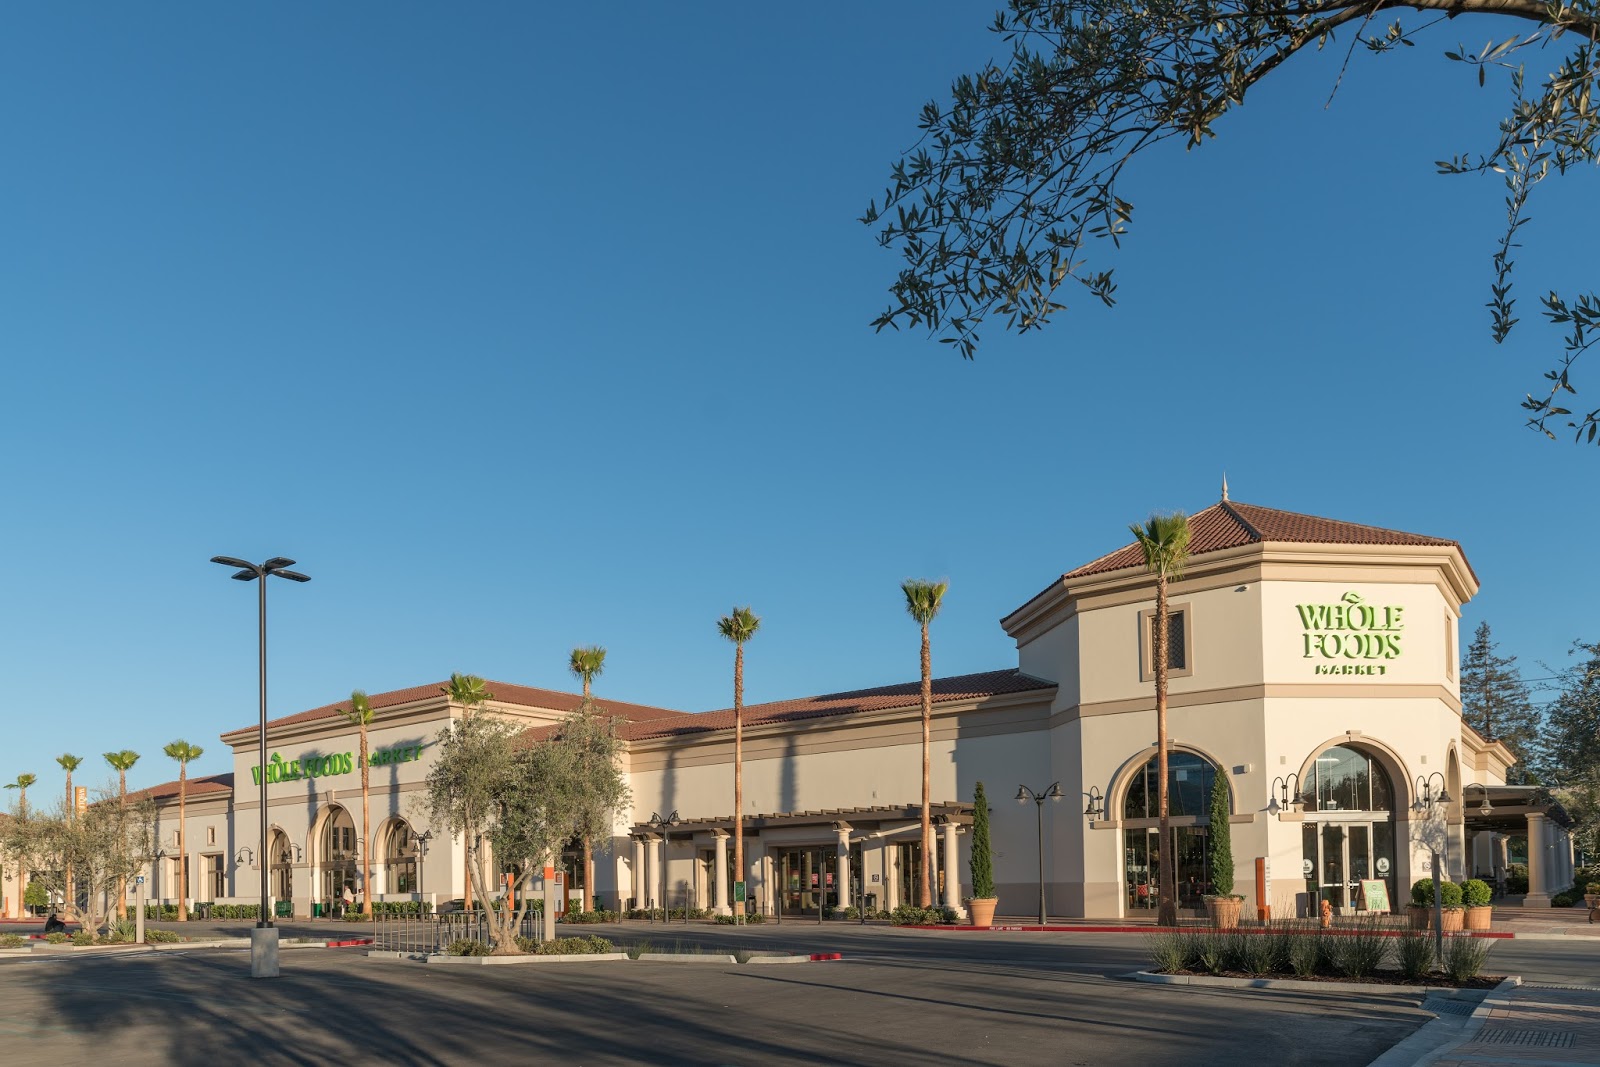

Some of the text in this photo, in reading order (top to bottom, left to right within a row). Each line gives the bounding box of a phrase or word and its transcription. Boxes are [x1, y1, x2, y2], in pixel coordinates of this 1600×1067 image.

[1295, 602, 1404, 631] WHOLE
[1302, 632, 1402, 659] FOODS
[1315, 664, 1386, 675] MARKET
[303, 752, 353, 779] FOODS
